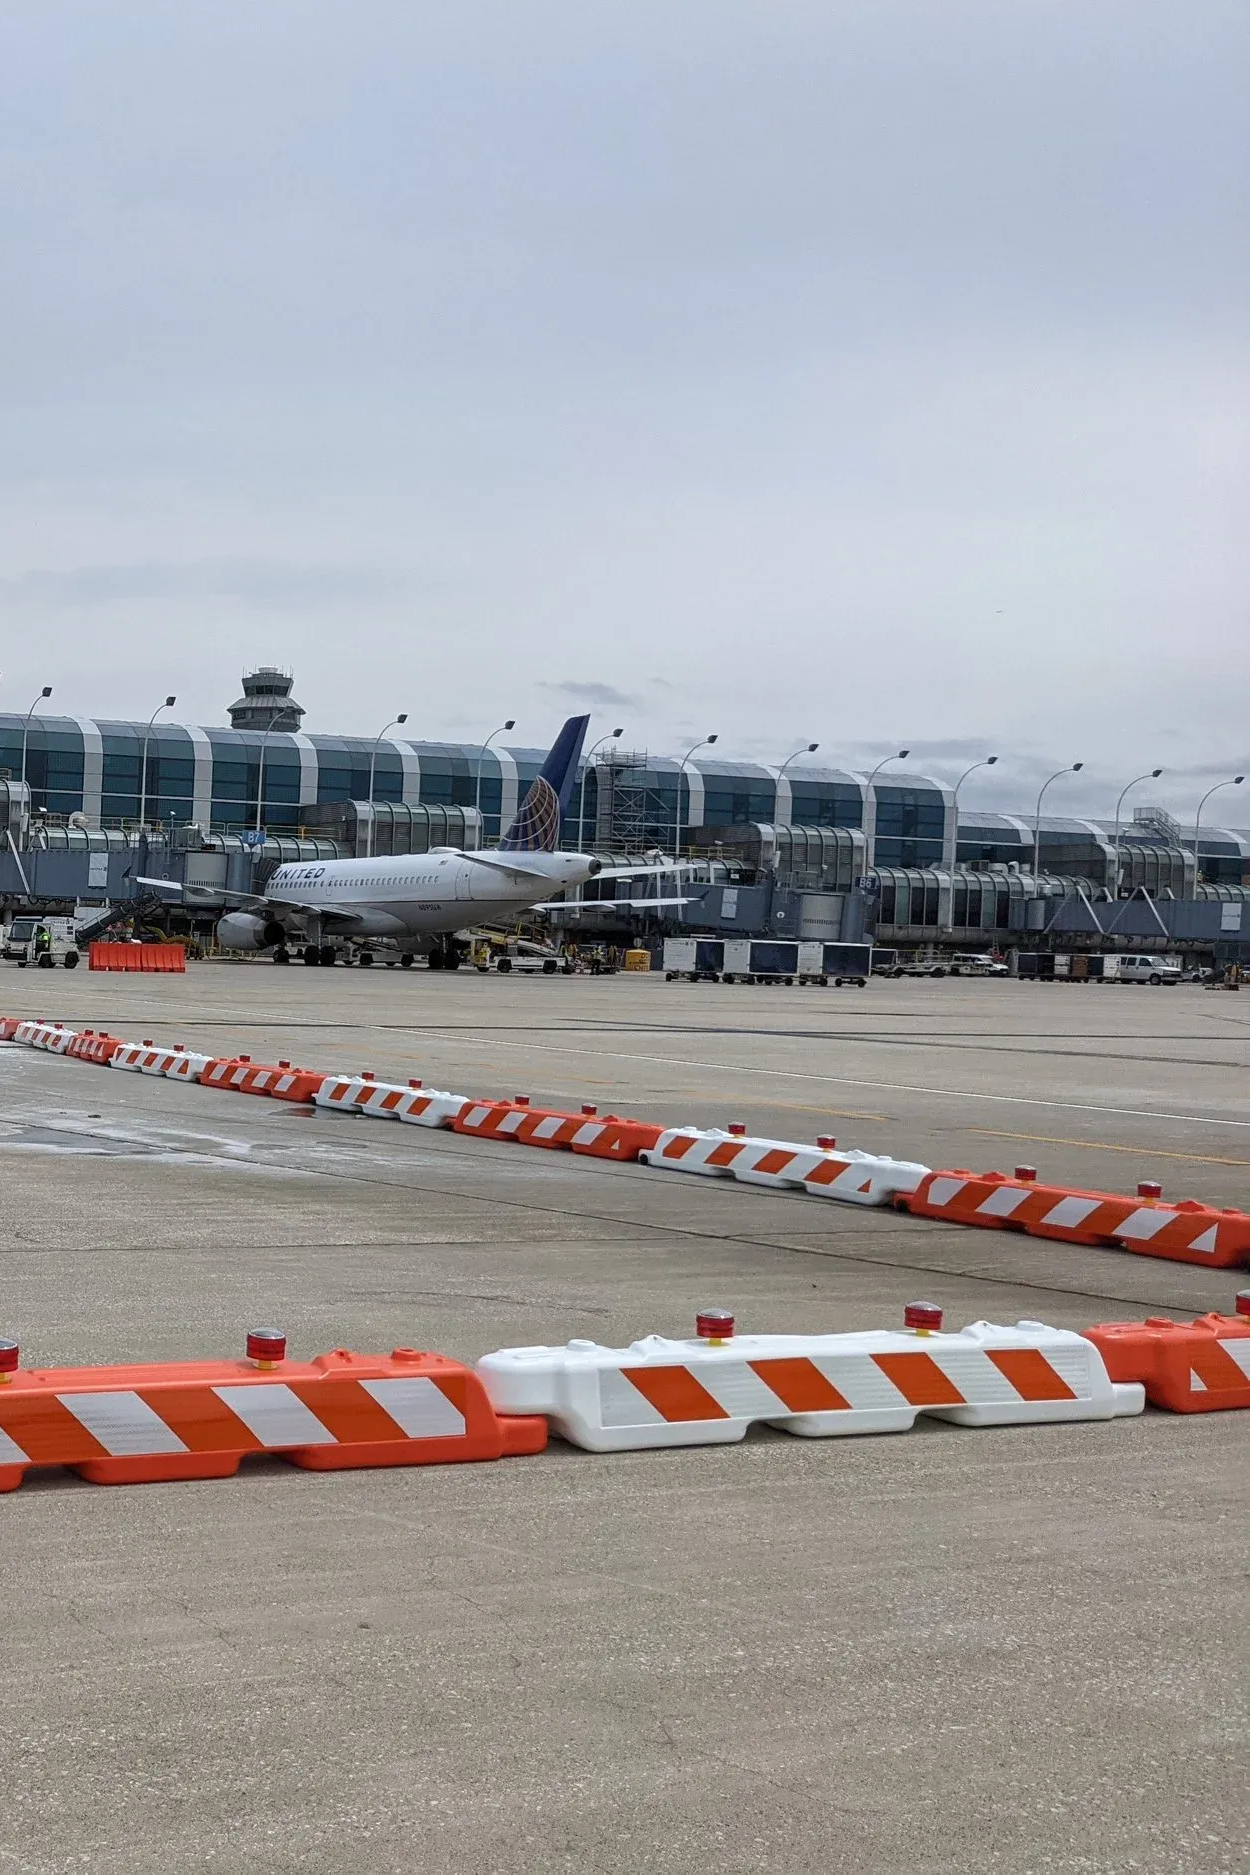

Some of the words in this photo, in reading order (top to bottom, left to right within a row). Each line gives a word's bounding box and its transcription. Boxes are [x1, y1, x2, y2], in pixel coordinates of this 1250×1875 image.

[247, 831, 260, 843] B7
[270, 867, 326, 881] UNITED
[859, 877, 872, 888] B6
